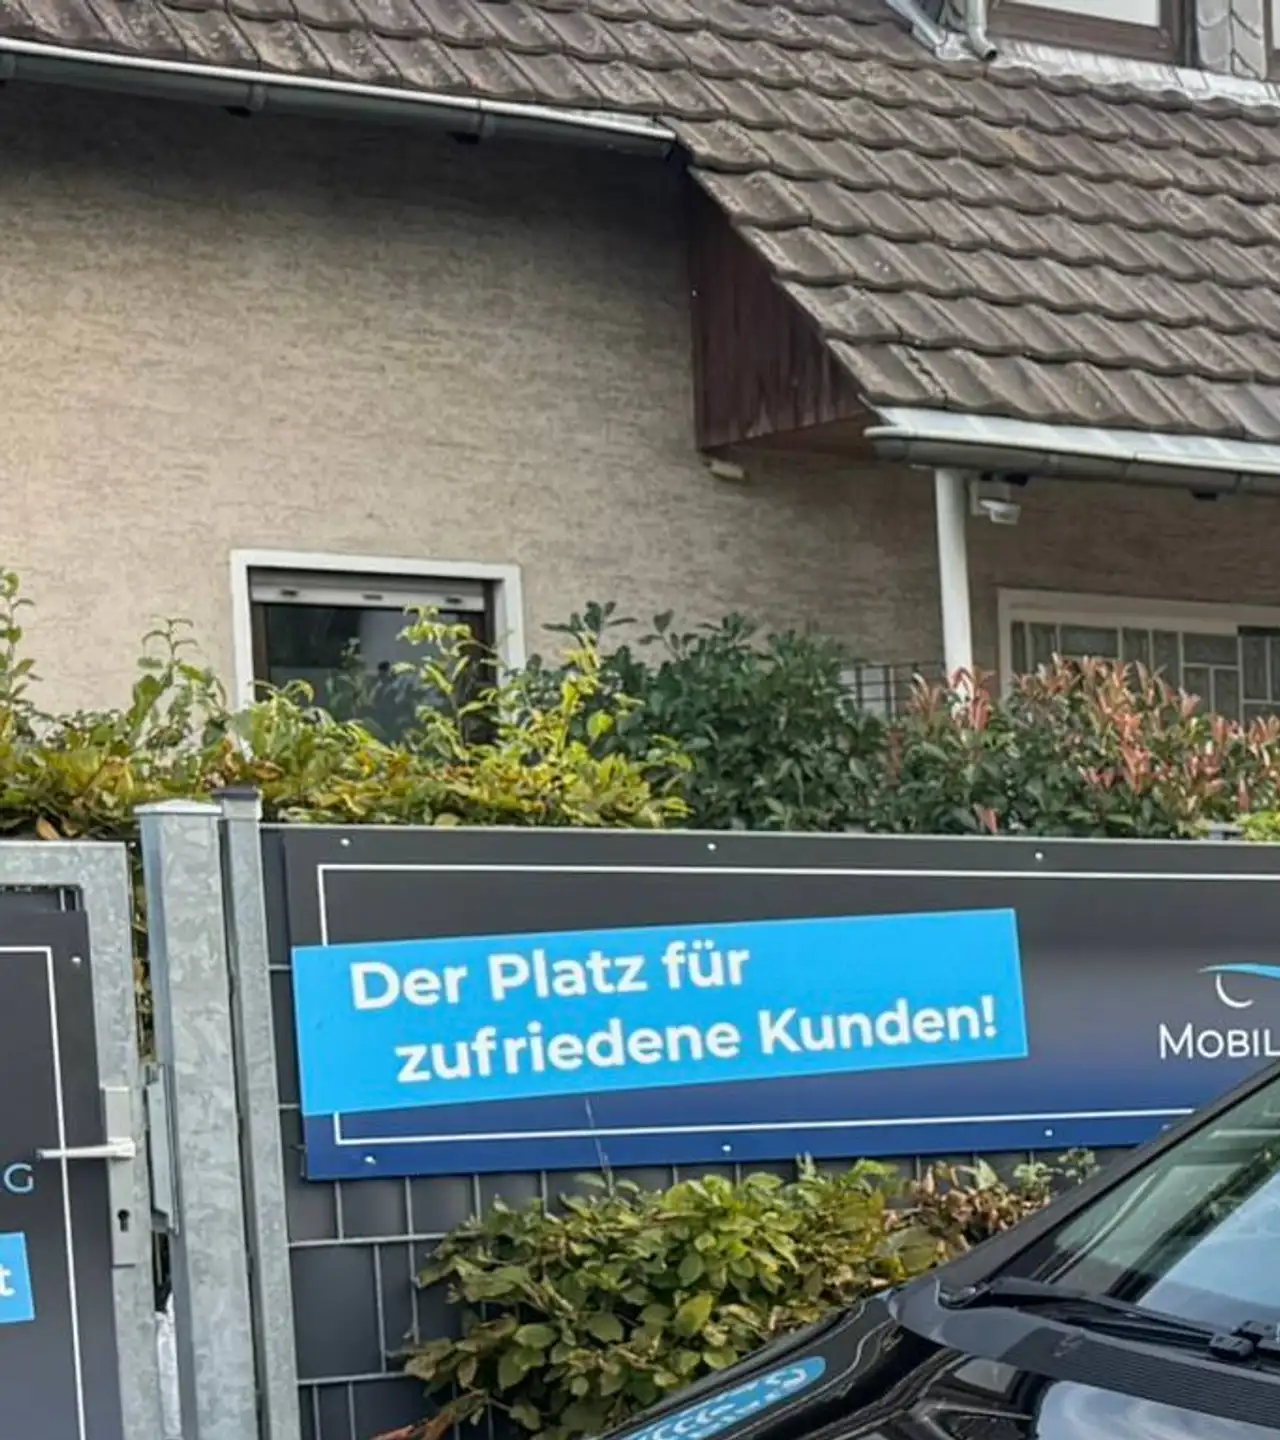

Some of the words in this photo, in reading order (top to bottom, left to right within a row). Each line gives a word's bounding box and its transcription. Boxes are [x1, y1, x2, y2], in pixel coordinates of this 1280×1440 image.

[350, 960, 468, 1010] Der
[487, 947, 648, 1001] Platz
[660, 938, 750, 990] für
[394, 1016, 741, 1083] zufriedene
[757, 994, 998, 1055] Kunden!
